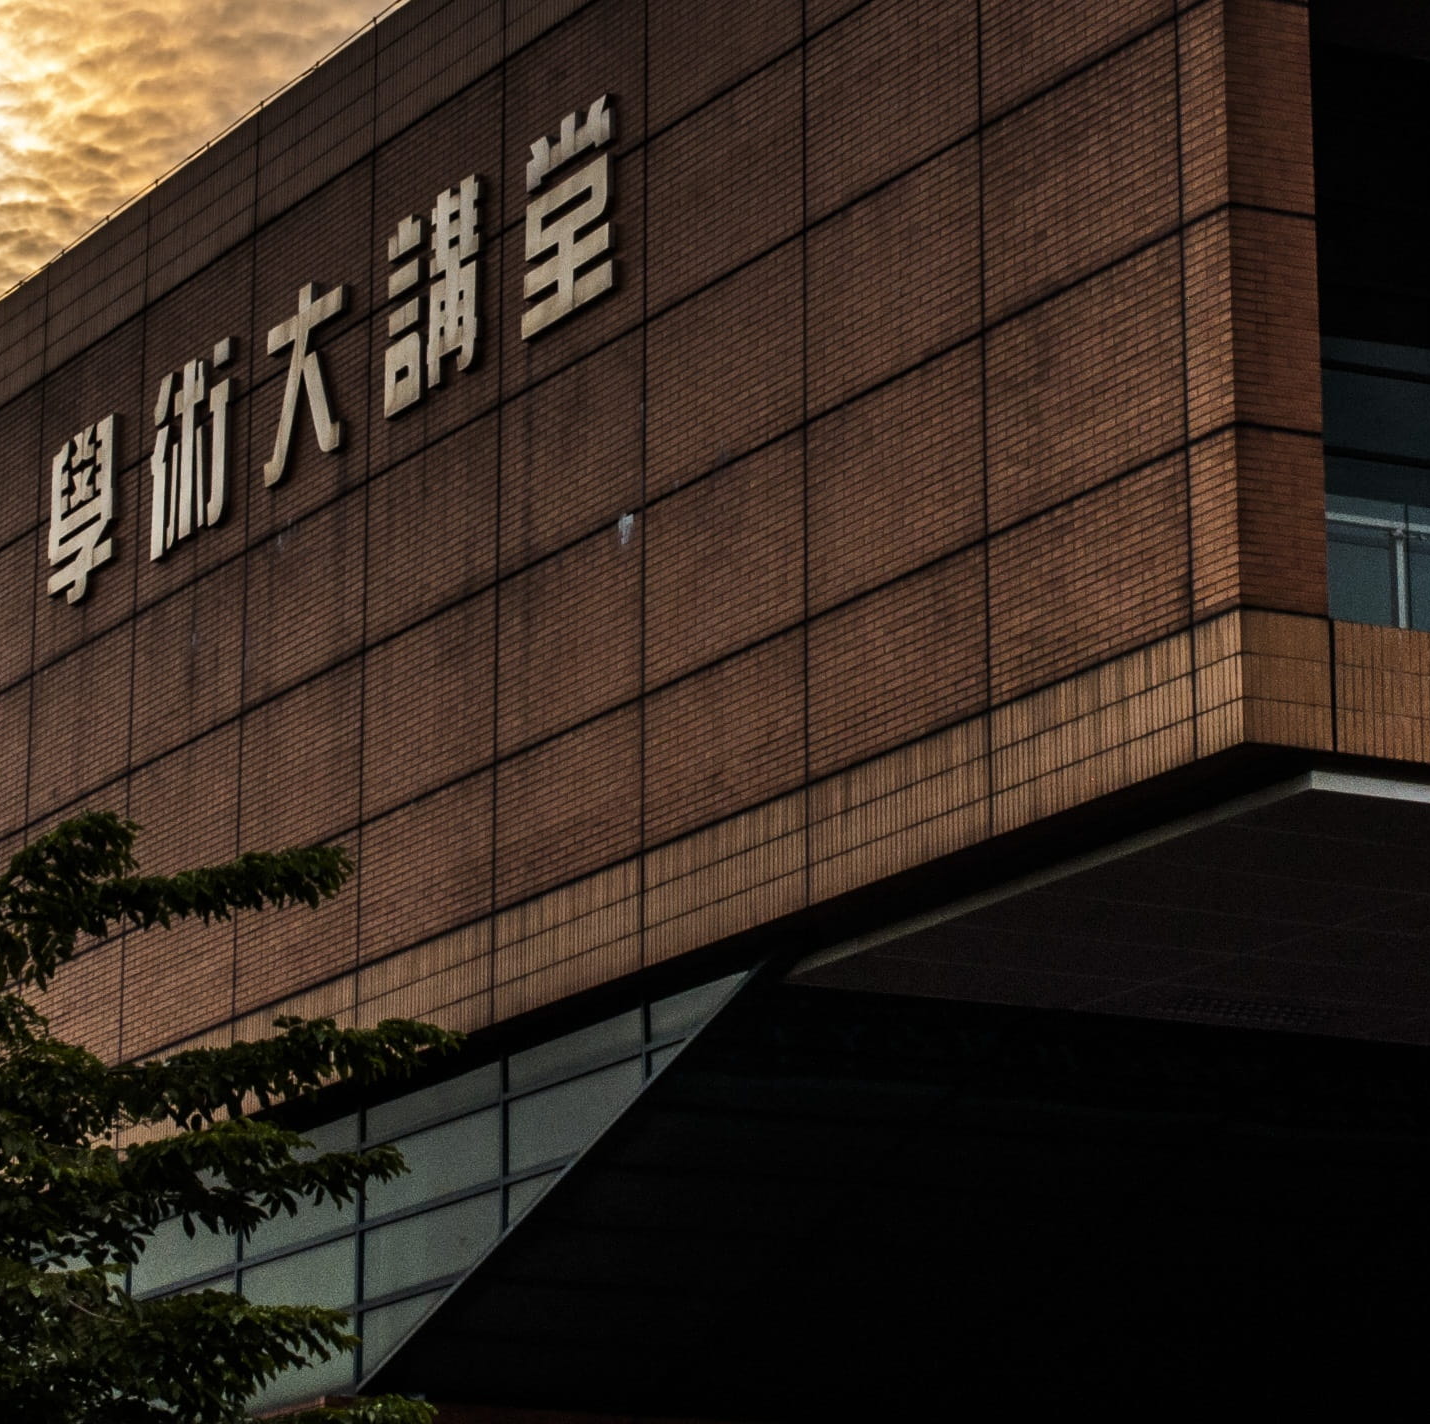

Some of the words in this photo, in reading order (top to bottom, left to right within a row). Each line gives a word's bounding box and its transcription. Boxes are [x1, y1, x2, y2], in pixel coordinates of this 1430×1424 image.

[47, 93, 616, 604] 學術大講堂
